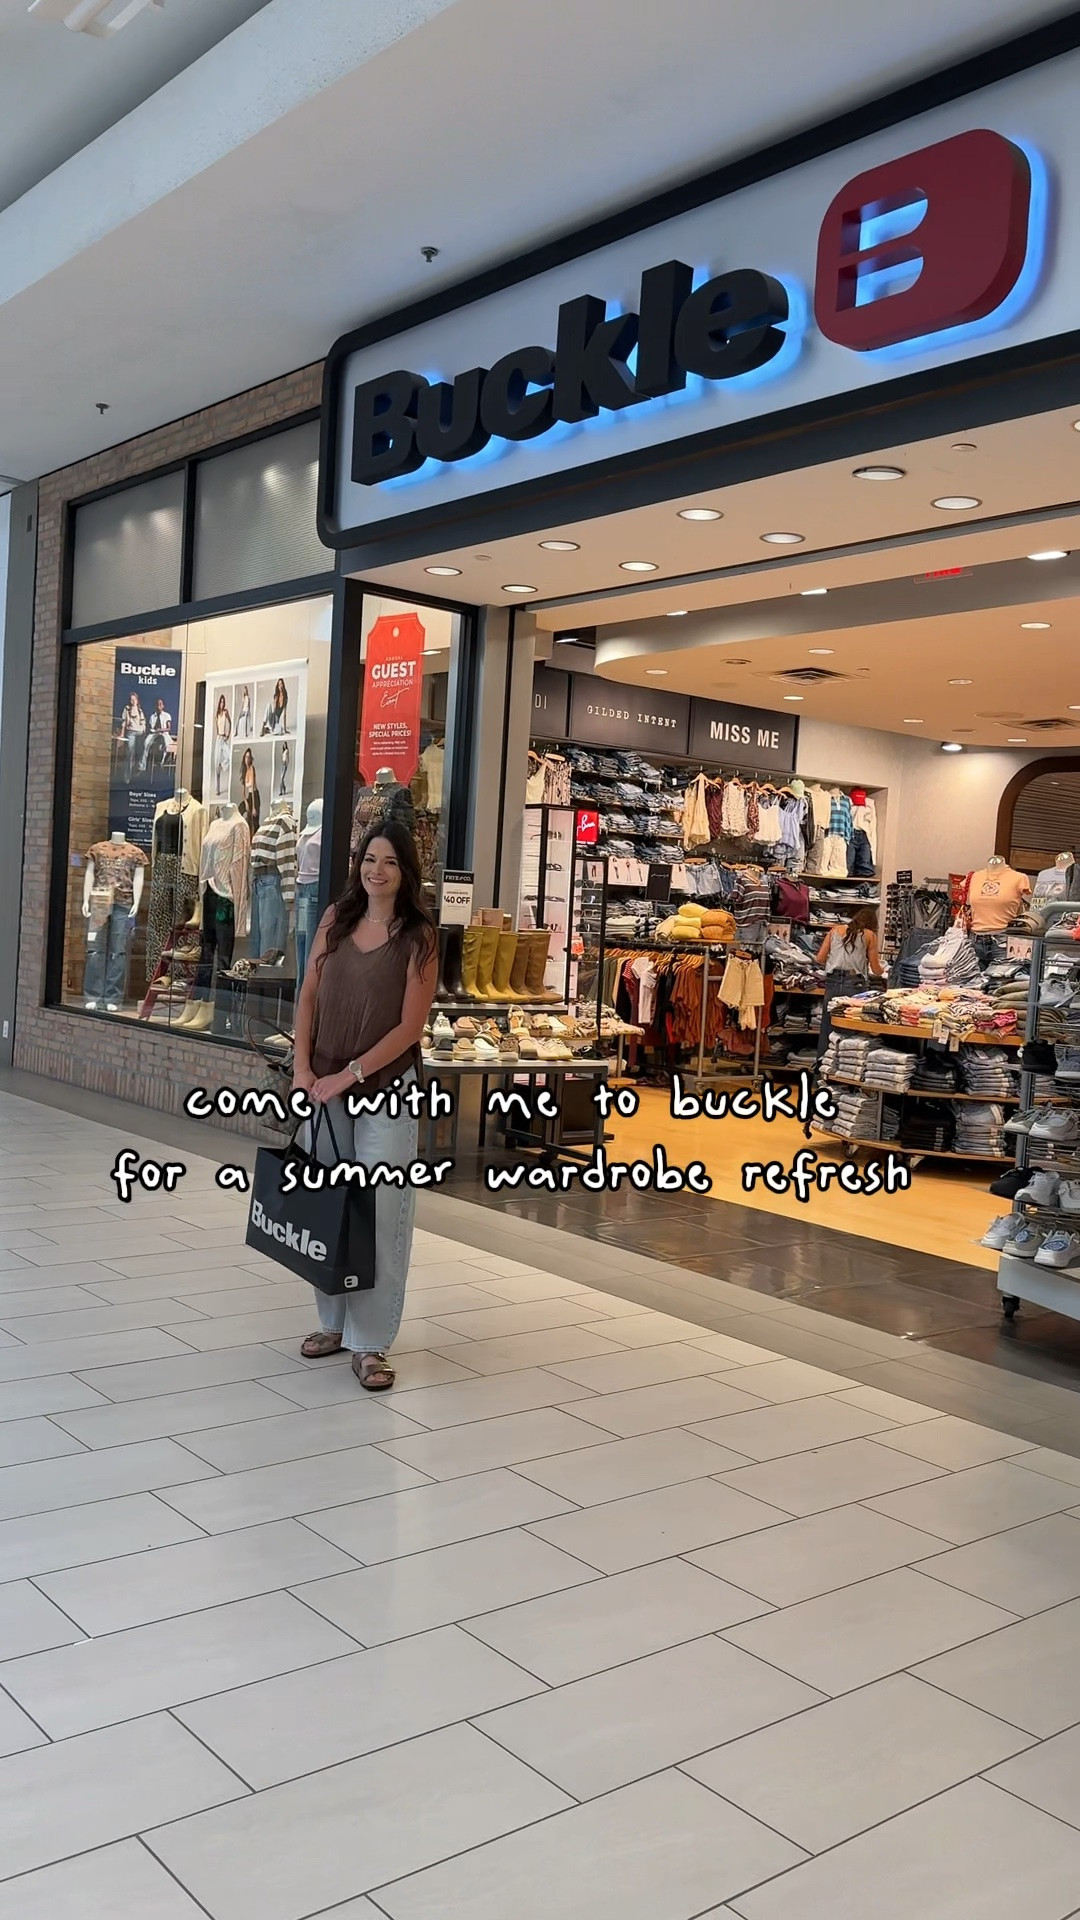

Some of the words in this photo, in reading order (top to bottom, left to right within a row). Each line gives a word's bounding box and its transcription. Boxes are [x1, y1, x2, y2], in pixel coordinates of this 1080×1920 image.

[350, 259, 790, 486] Buckle
[120, 662, 176, 677] Buckle
[371, 661, 417, 680] GUEST
[138, 675, 158, 685] kids
[371, 679, 414, 689] APPRECIATION
[586, 705, 630, 720] GILDED
[637, 713, 677, 728] INTENT
[386, 722, 408, 730] STYLES,
[710, 720, 751, 745] MISS
[757, 728, 780, 749] ME
[456, 896, 471, 905] OFF
[251, 1199, 328, 1262] Buckle
